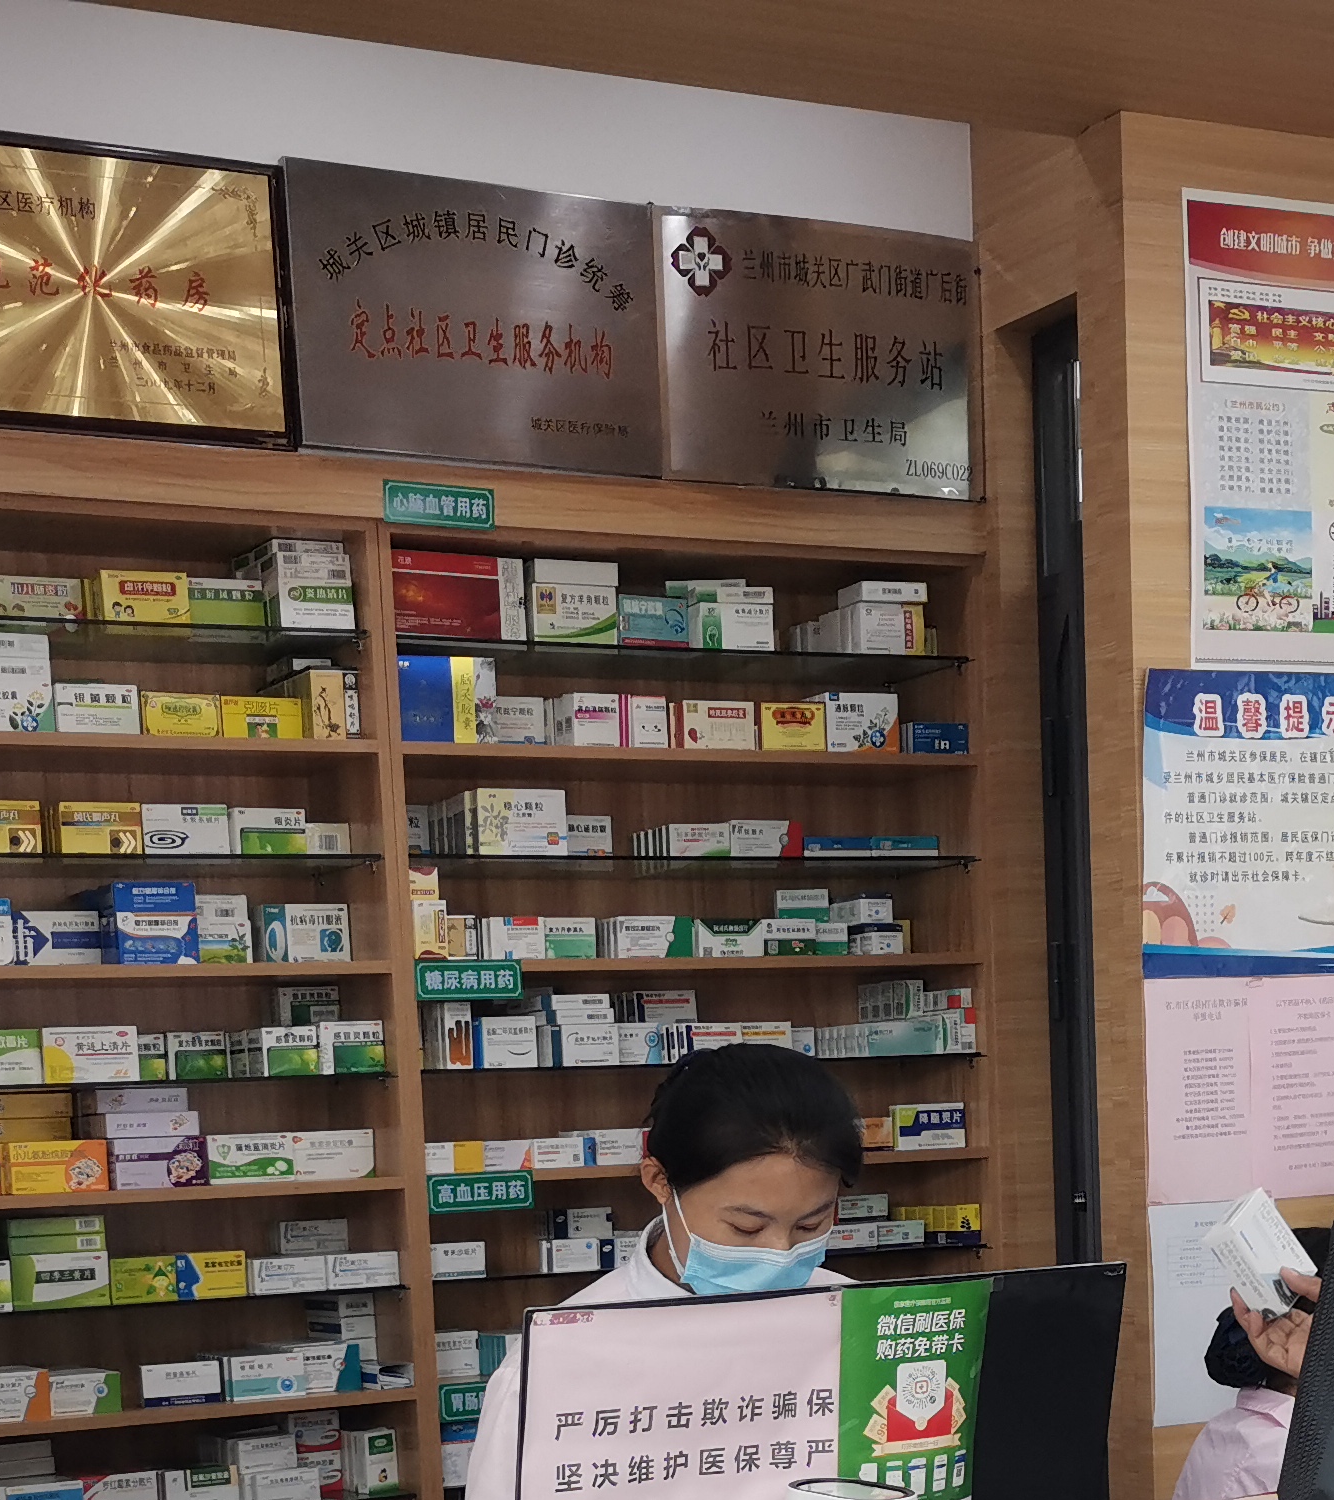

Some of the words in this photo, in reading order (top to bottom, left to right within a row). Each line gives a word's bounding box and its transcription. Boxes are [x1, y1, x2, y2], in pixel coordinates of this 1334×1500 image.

[1220, 228, 1301, 258] 创建文明城市
[320, 208, 634, 314] 城关区城镇居民门诊统筹
[742, 249, 968, 306] 兰州市城关区广武门街道广后街
[351, 299, 615, 379] 定点社区卫生服务机构
[1272, 328, 1299, 340] 民主
[1272, 341, 1299, 353] 平等
[110, 355, 238, 378] 兰州市卫生局
[707, 318, 944, 391] 社区卫生服务站
[530, 417, 630, 439] 城关区医疗保险局
[760, 411, 909, 447] 兰州市卫生局
[905, 458, 973, 482] ZL069C022
[393, 490, 487, 521] 心脑血管用药
[1163, 811, 1263, 825] 件的社区卫生服务站。
[1188, 870, 1308, 884] 就诊时请出示社会保障卡。
[425, 969, 514, 991] 糖尿病用药
[436, 1179, 526, 1204] 高血压用药
[876, 1309, 966, 1336] 微信刷医保
[876, 1332, 966, 1361] 购药免带卡
[554, 1387, 836, 1441] 严厉打击欺诈骗保
[554, 1438, 836, 1494] 坚决维护医保尊严
